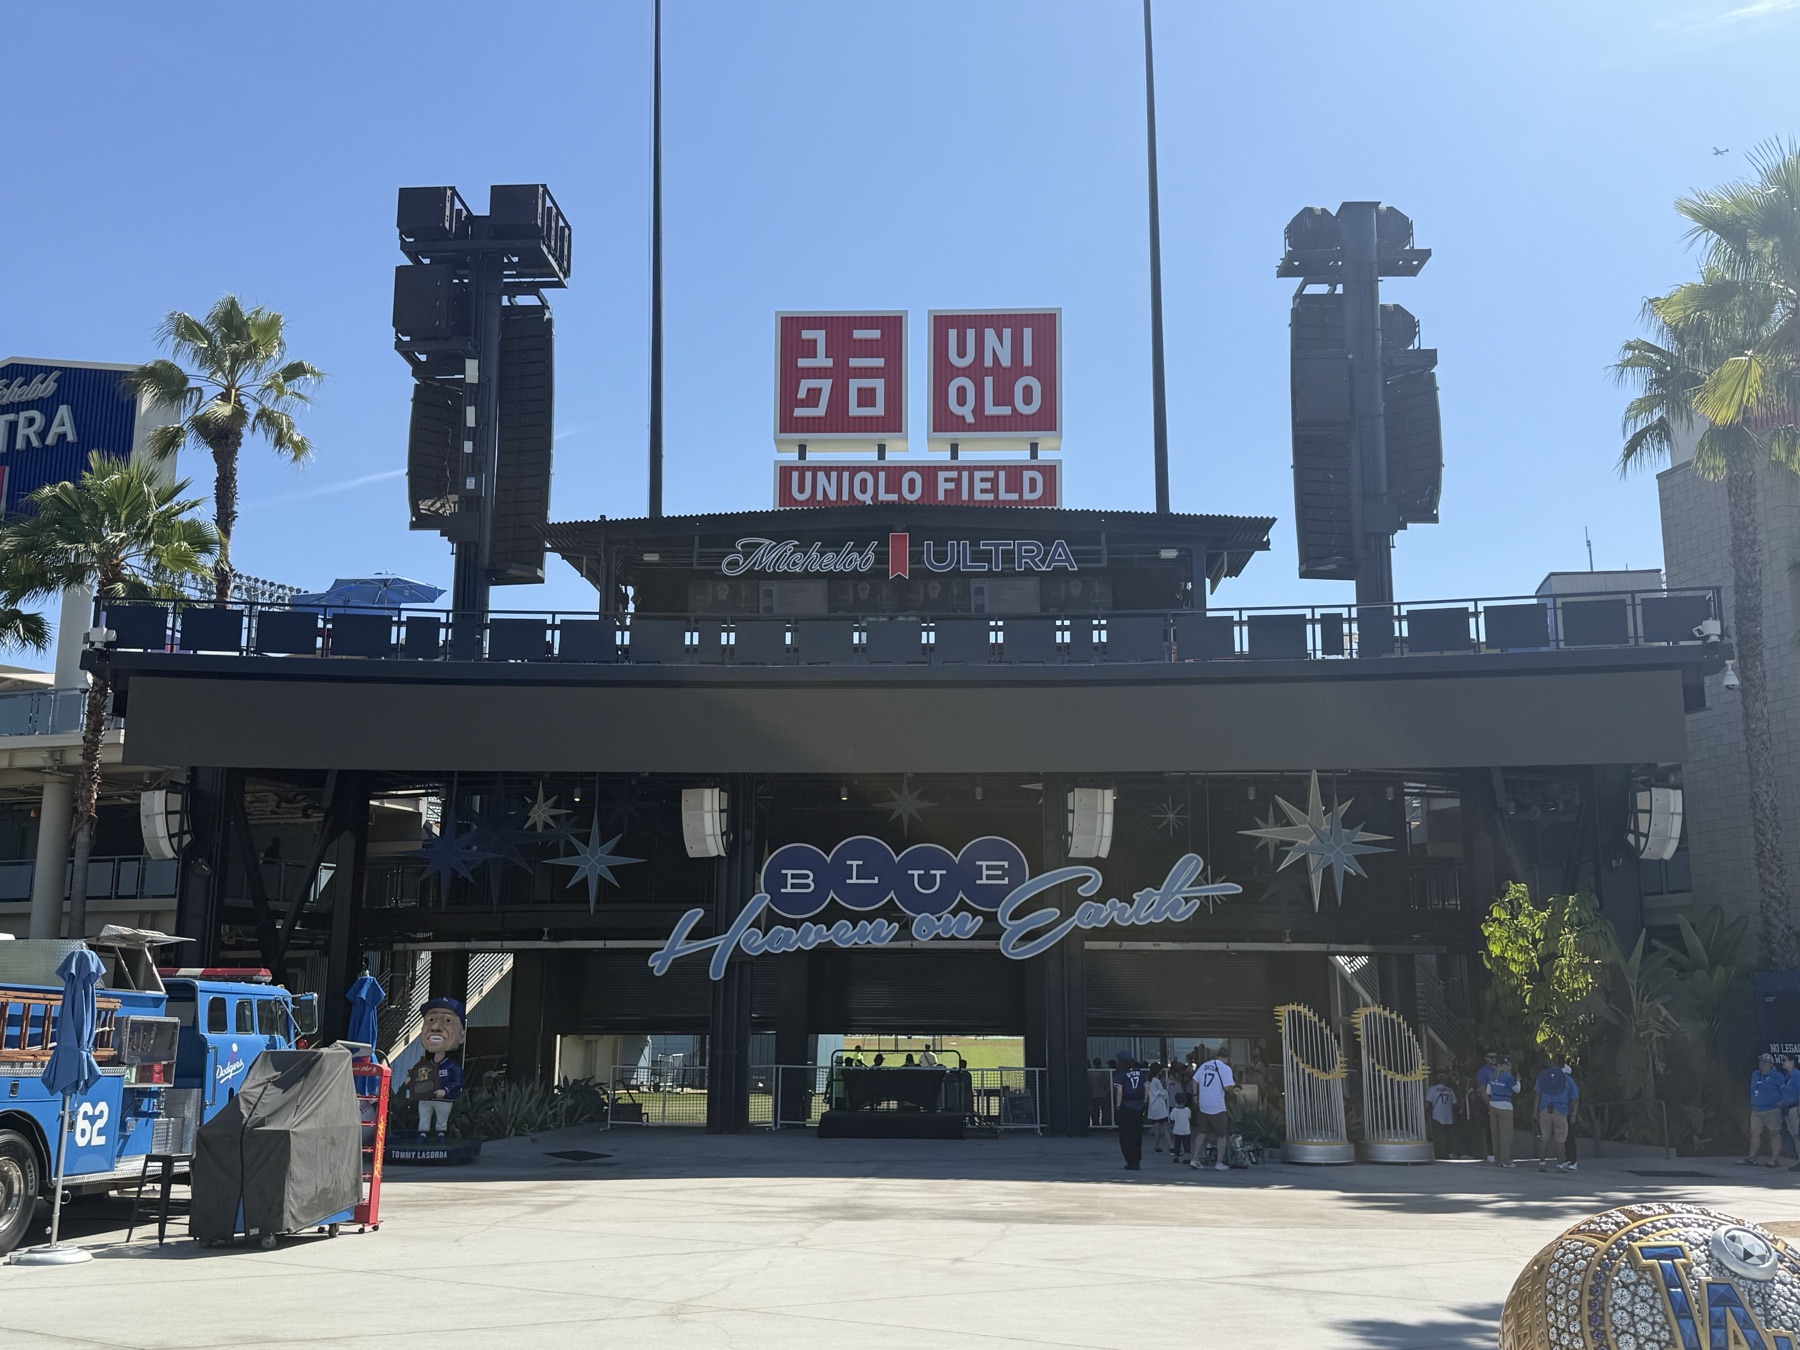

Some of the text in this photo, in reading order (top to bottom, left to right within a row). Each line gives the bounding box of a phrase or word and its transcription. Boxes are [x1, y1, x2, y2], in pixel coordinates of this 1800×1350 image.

[797, 329, 885, 368] ユニ
[948, 328, 1033, 368] UNI
[793, 378, 885, 417] クロ
[948, 375, 1042, 423] QLO
[791, 470, 1044, 504] UNIQLO FIELD
[721, 537, 1078, 576] Michelob ULTRA
[780, 859, 1010, 894] BLUE
[648, 853, 1243, 981] Heaven on Earth
[1769, 1043, 1780, 1053] NO
[215, 1058, 245, 1084] Dodgers
[1203, 1072, 1215, 1087] 17
[73, 1101, 109, 1148] 62
[391, 1150, 448, 1159] TOMMY LASORDA
